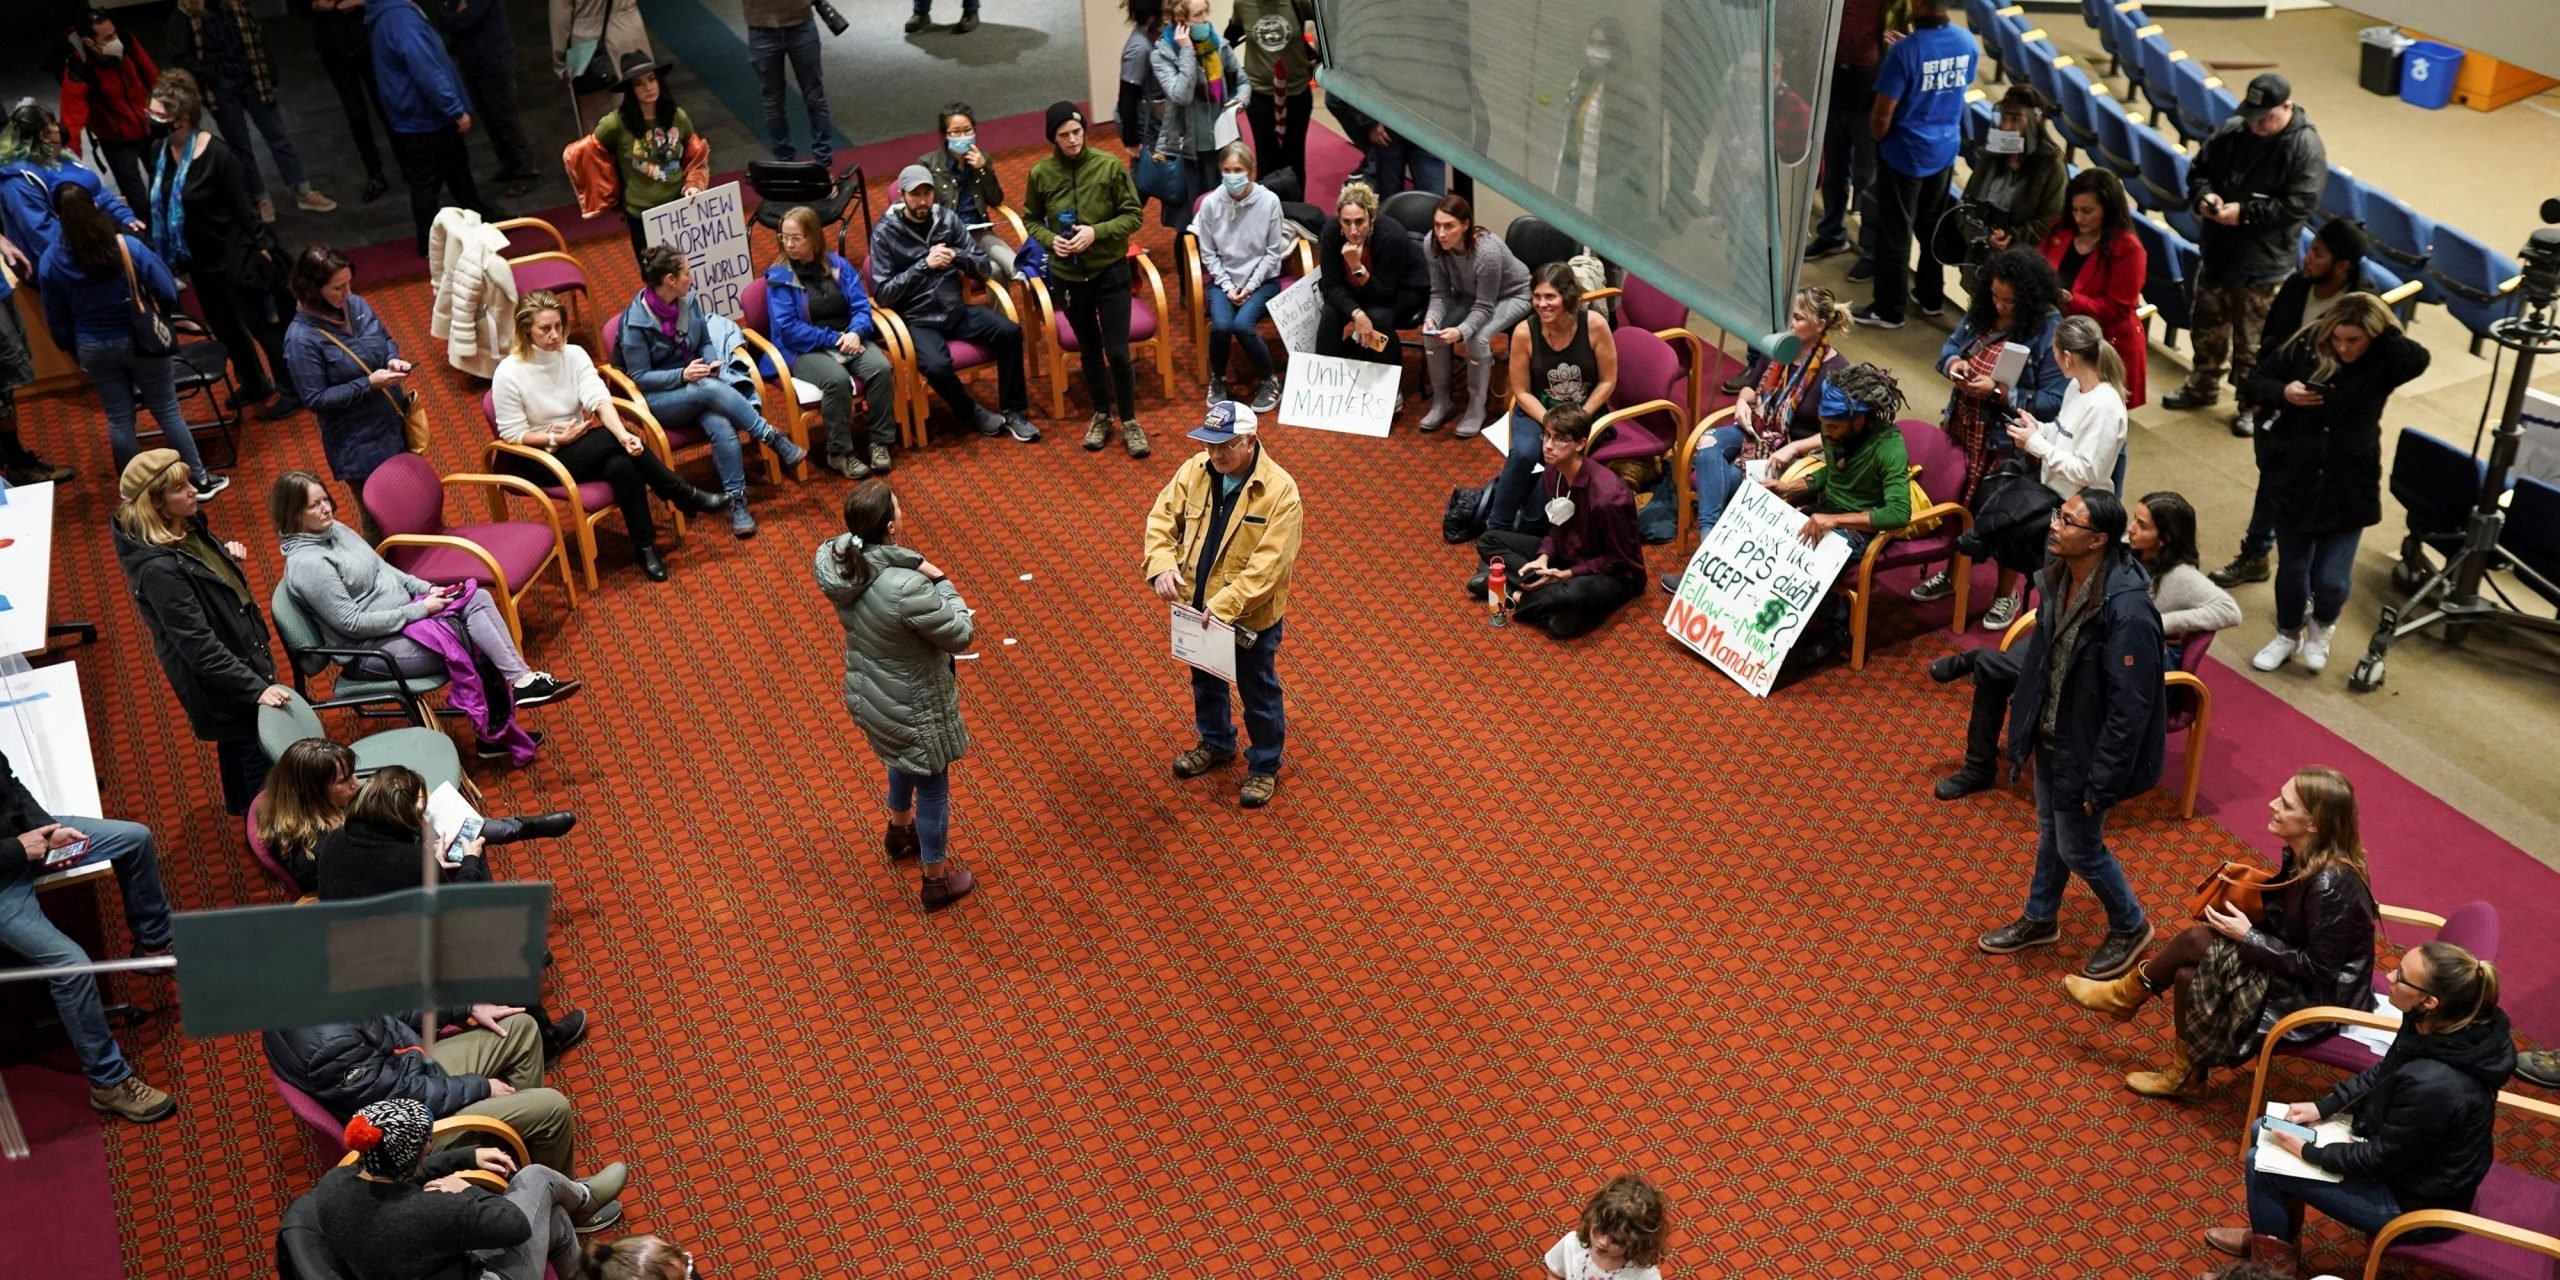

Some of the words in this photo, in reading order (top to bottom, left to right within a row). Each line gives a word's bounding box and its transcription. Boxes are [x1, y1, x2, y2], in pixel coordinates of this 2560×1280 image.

[1921, 69, 1967, 92] BACK
[650, 206, 691, 235] THE
[697, 193, 734, 222] NEW
[704, 254, 750, 287] WORLD
[1307, 360, 1360, 406] Unity
[1292, 389, 1386, 423] MATTERS
[1727, 507, 1752, 533] this
[1741, 482, 1785, 527] What
[1714, 525, 1738, 546] if
[1734, 540, 1777, 580] PPS
[1786, 547, 1815, 577] like
[1692, 551, 1755, 601] ACCEPT
[1668, 599, 1708, 643] NO
[1680, 573, 1724, 620] Follow
[1736, 617, 1780, 667] Money
